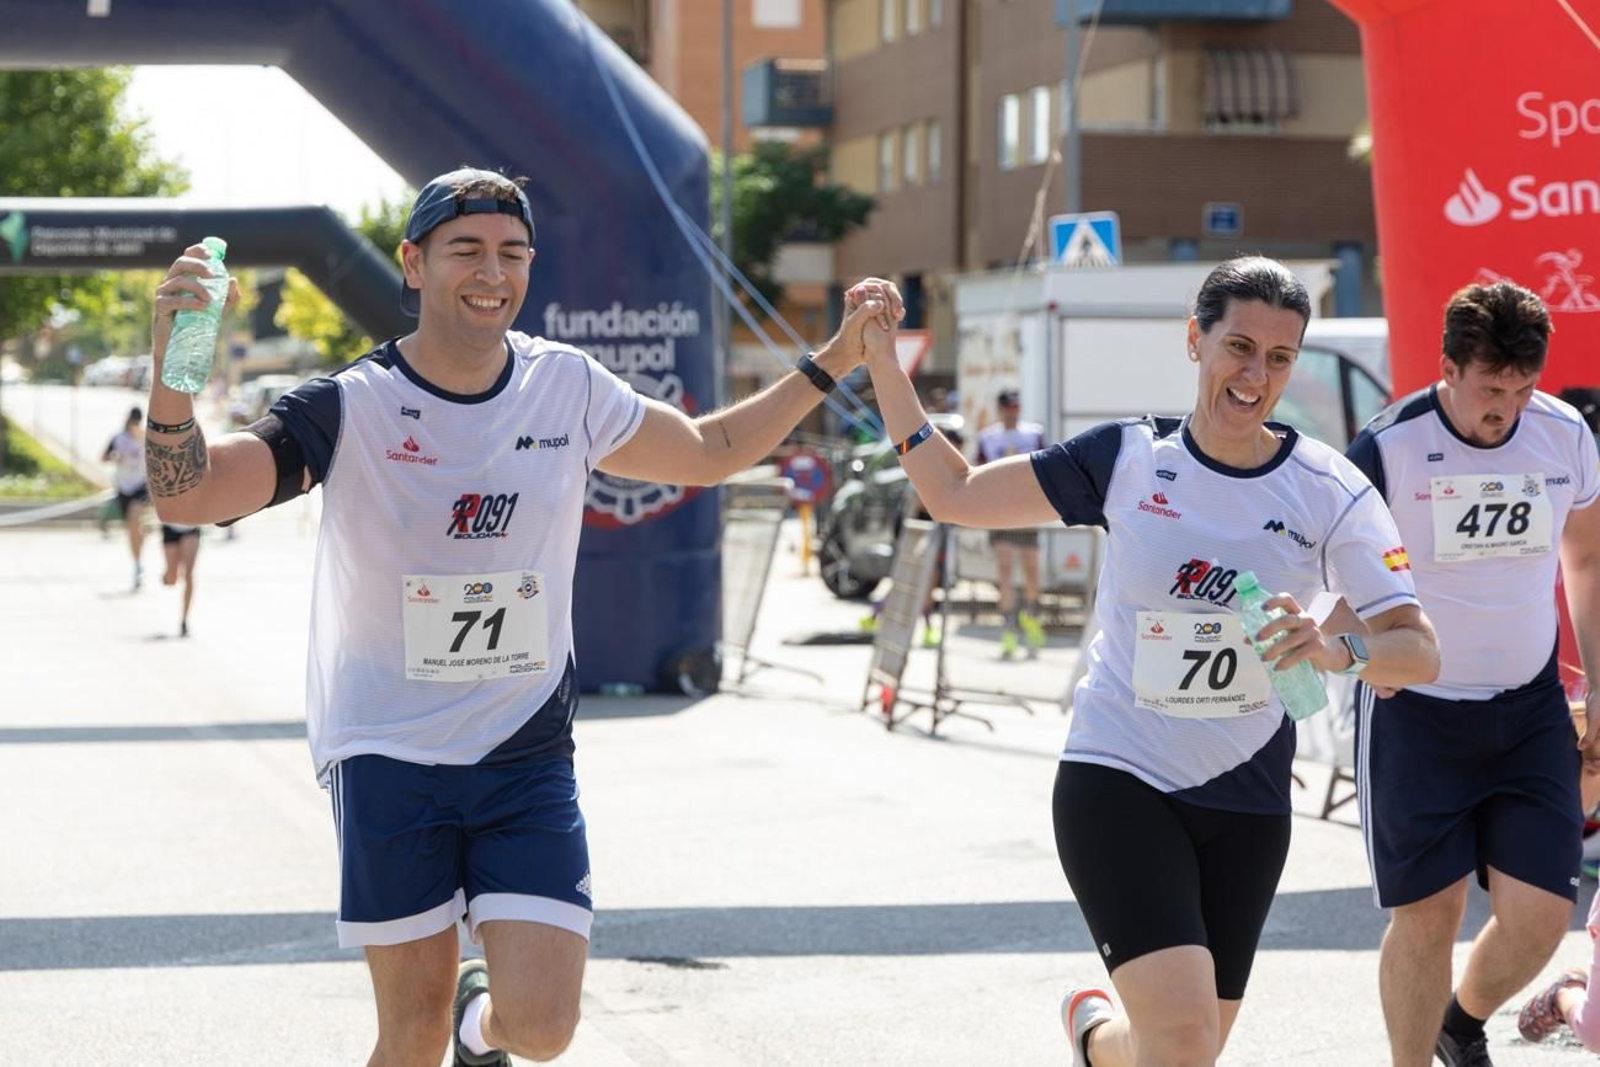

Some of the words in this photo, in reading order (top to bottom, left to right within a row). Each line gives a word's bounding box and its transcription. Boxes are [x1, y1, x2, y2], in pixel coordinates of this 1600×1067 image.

[1508, 175, 1600, 220] San
[543, 302, 700, 338] fundación
[539, 433, 570, 450] mupol
[386, 449, 438, 465] Santander
[1137, 500, 1182, 520] Santander
[1456, 501, 1531, 538] 478
[449, 607, 506, 653] 71
[423, 657, 447, 667] MANUEL
[448, 656, 465, 667] JOSÉ
[466, 656, 492, 666] MORENO
[493, 655, 501, 664] DE
[502, 655, 510, 663] LA
[511, 652, 529, 661] TORRE
[1178, 647, 1237, 691] 70
[1165, 696, 1194, 704] LOURDES
